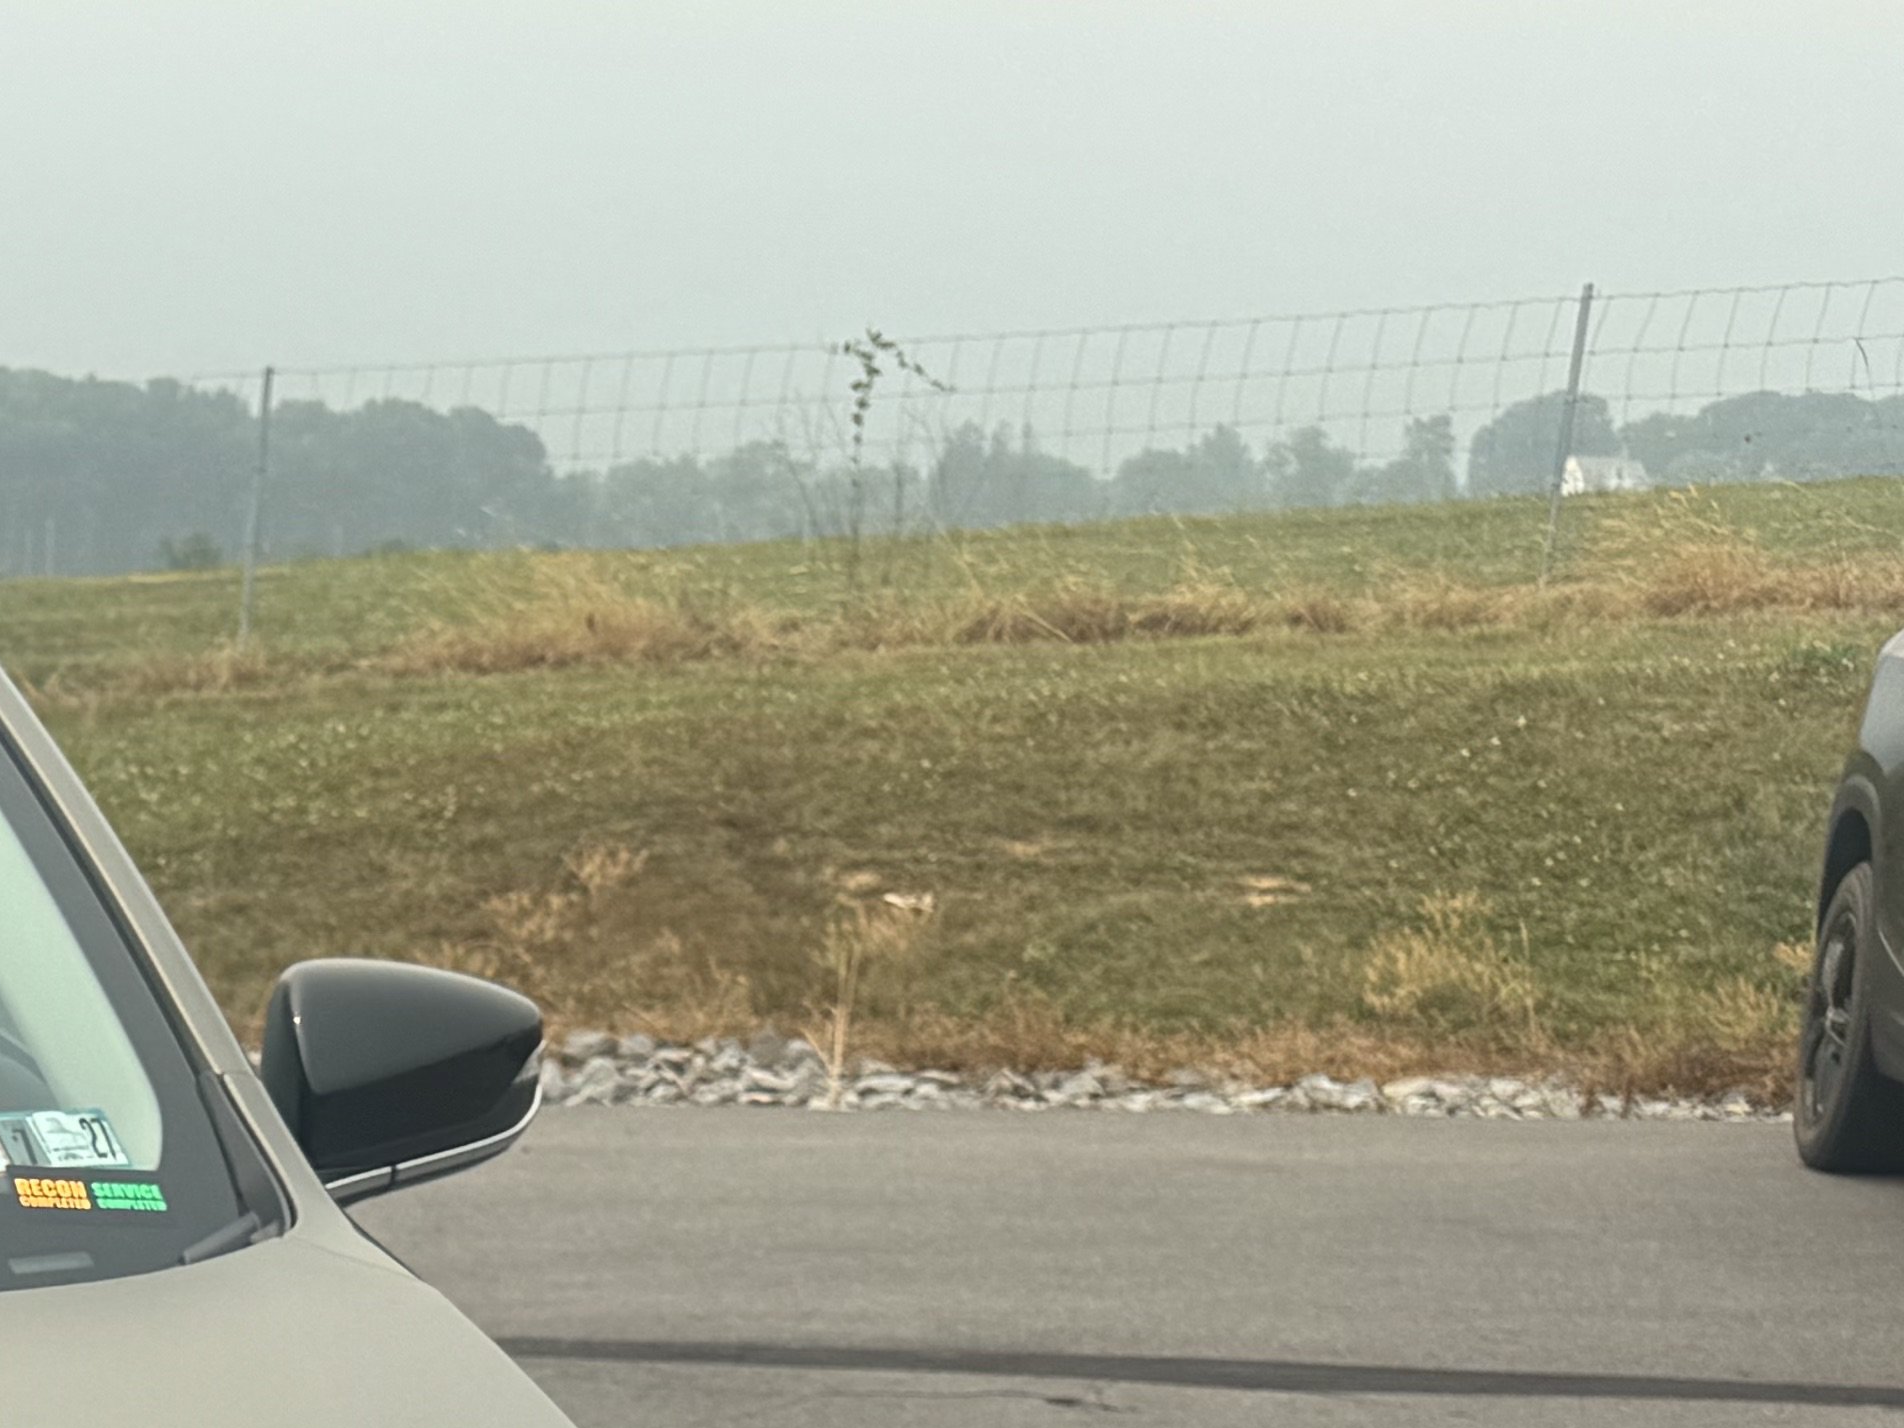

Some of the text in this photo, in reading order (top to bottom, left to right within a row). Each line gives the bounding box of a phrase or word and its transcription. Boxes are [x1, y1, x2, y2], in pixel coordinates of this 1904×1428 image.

[79, 1117, 117, 1161] 27
[14, 1178, 87, 1197] RECON
[91, 1182, 163, 1199] SERVICE
